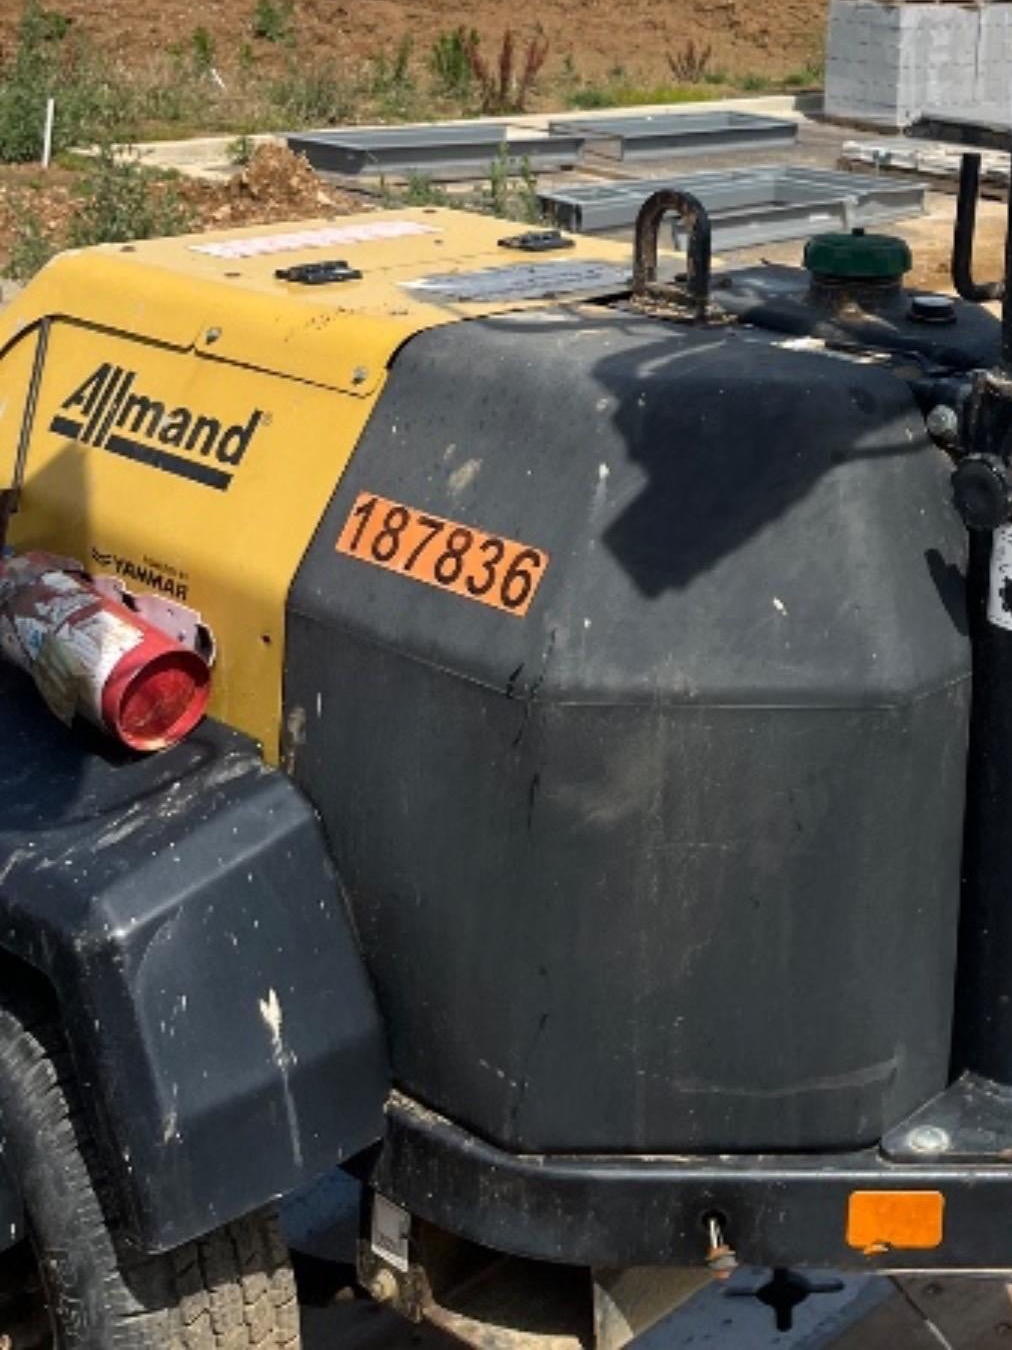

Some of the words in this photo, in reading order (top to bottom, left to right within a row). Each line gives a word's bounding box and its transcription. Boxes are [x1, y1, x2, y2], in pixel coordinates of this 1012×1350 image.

[61, 362, 263, 466] Allmand
[112, 554, 188, 602] YANMAR
[350, 497, 541, 608] 187836
